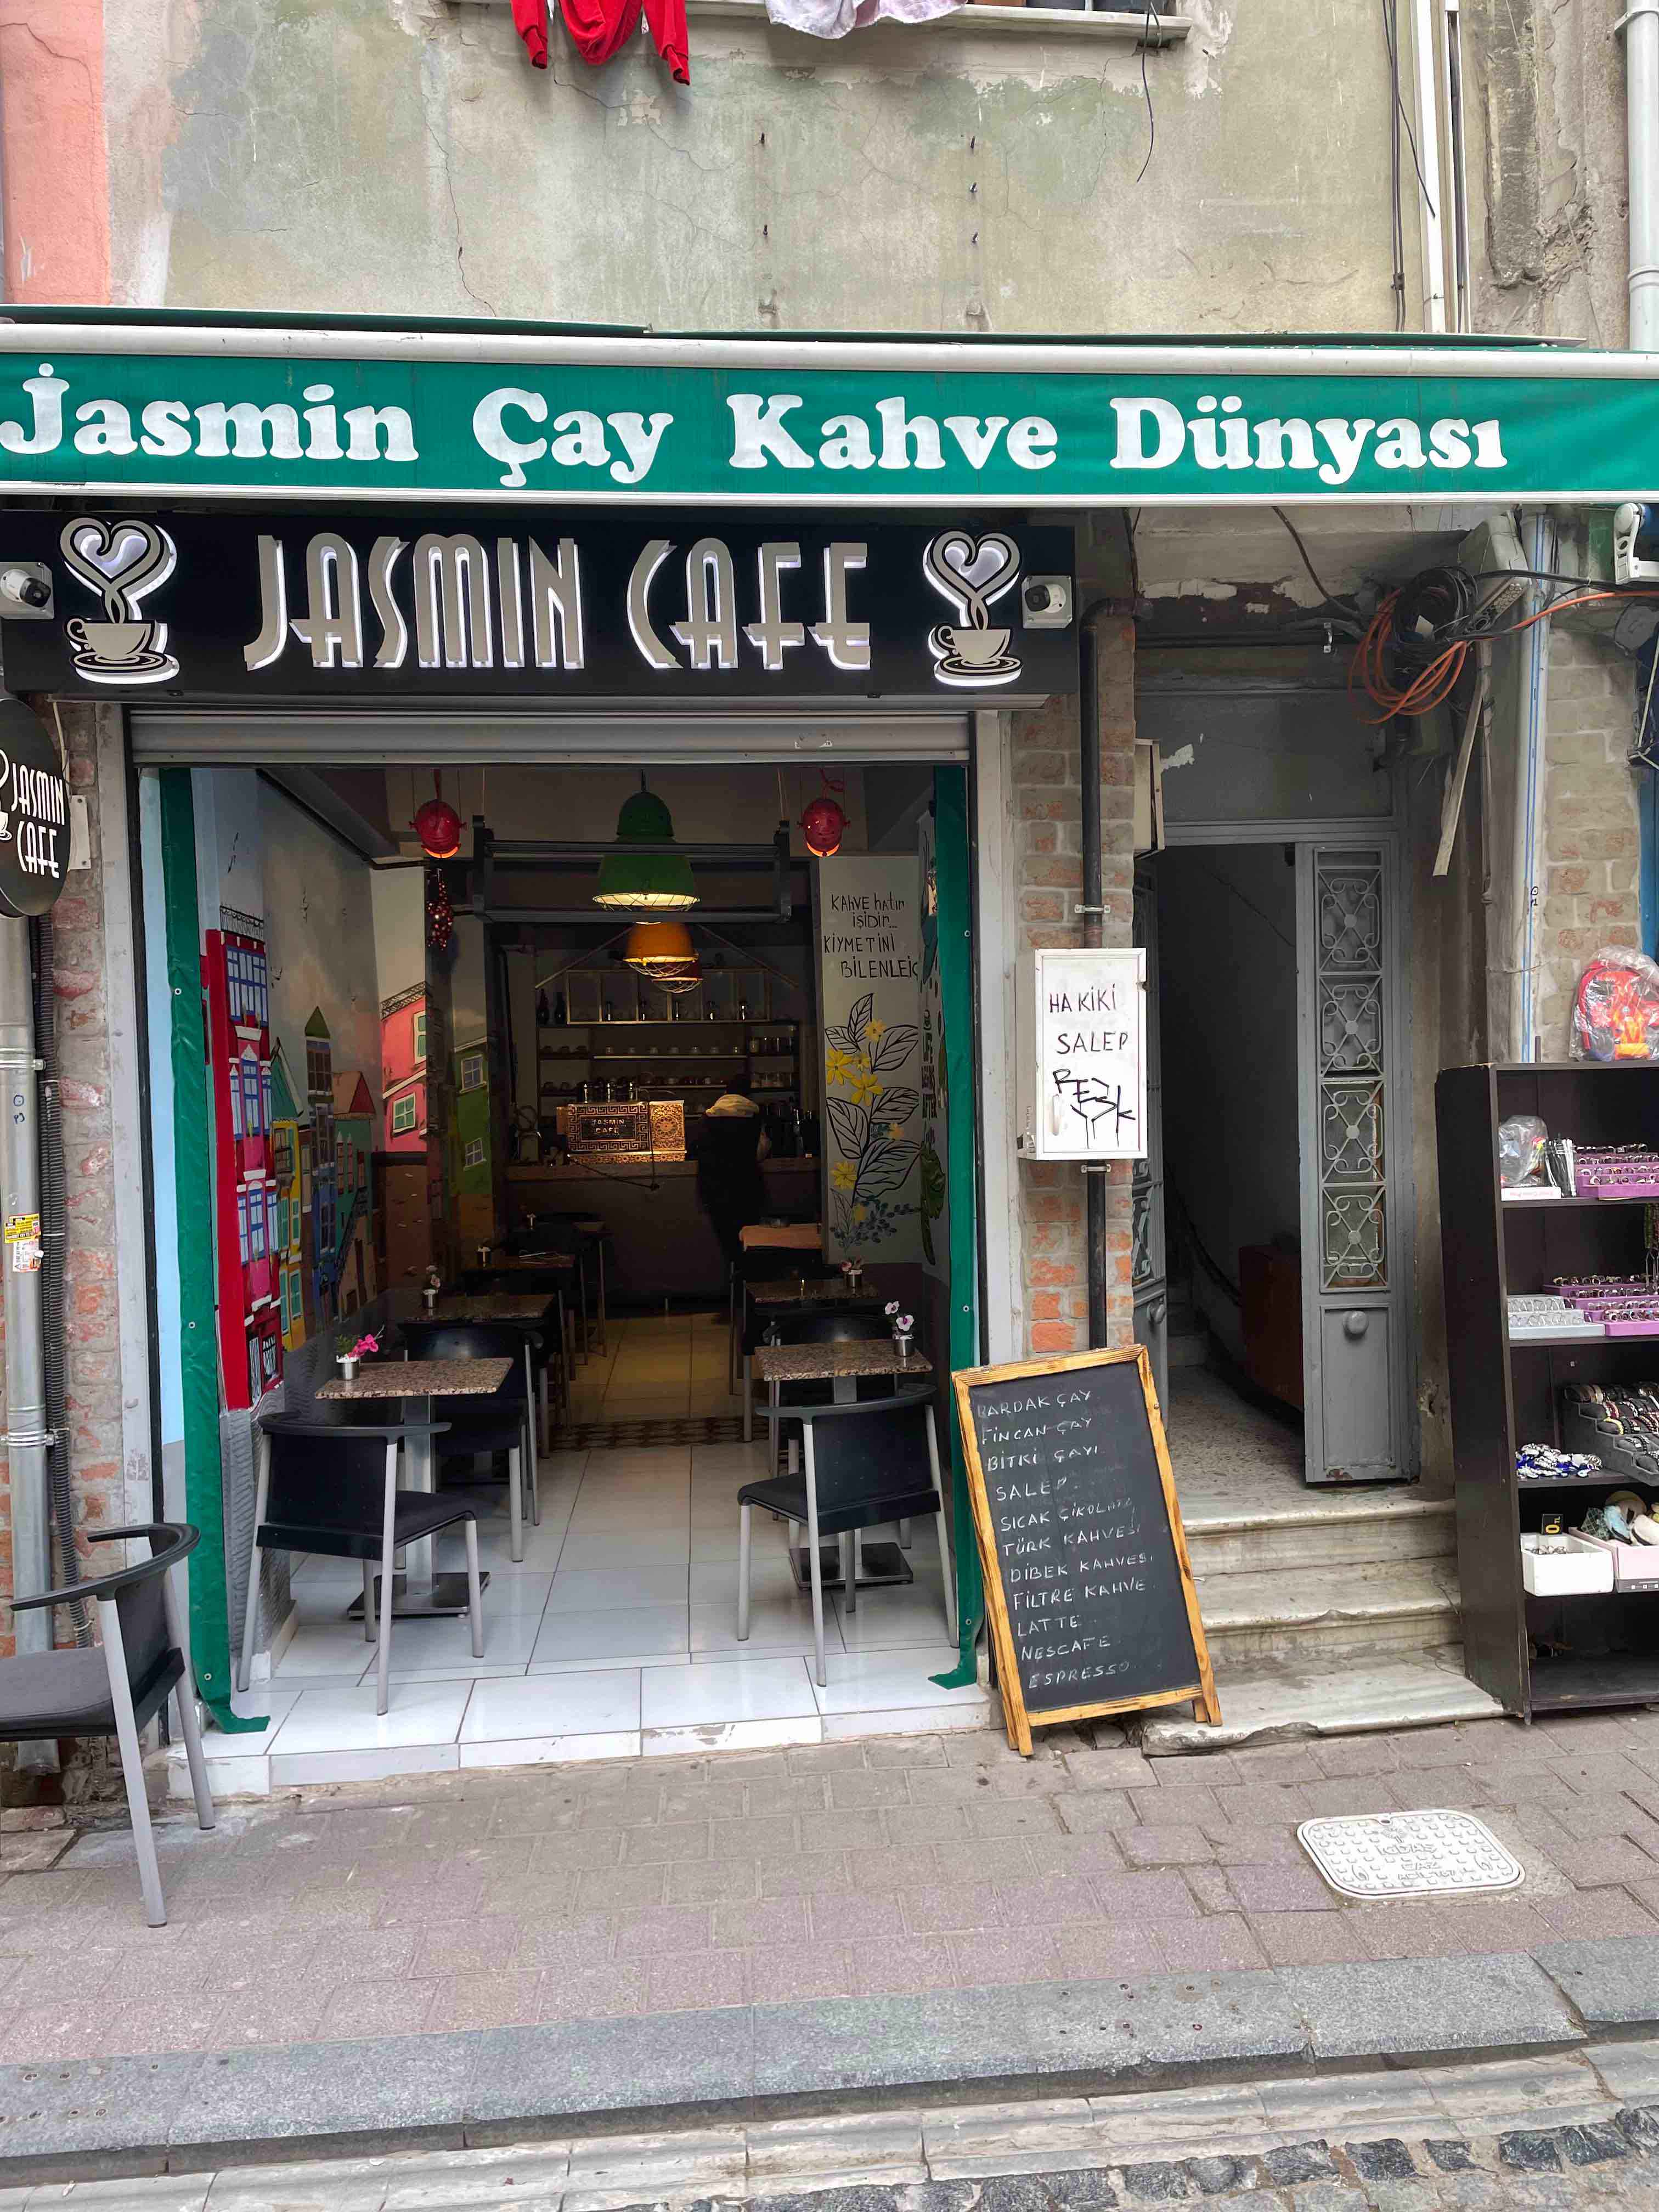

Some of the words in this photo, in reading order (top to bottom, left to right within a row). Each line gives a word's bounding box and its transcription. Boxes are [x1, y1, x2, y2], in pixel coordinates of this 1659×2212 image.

[2, 362, 420, 462] Jasmin
[472, 387, 674, 487] Çay
[726, 393, 1059, 470] Kahve
[1109, 395, 1508, 487] Dünyası
[243, 531, 585, 671] JASMIN
[627, 539, 873, 672] CAFE
[11, 763, 65, 825] JASMIN
[17, 820, 59, 878] CAFE
[1056, 1031, 1128, 1054] SALEP
[977, 1395, 1051, 1418] BARDAK
[1057, 1389, 1091, 1407] ÇAY
[981, 1424, 1047, 1444] FİNCAN
[1056, 1417, 1092, 1435] ÇAY
[987, 1448, 1037, 1471] BİTKİ
[1054, 1445, 1098, 1463] ÇAYI
[996, 1476, 1067, 1502] SALEP
[1000, 1511, 1051, 1532] SICAK
[1002, 1537, 1052, 1557] TÜRK
[1010, 1563, 1068, 1583] DİBEK
[1013, 1589, 1074, 1611] FİLTRE
[1085, 1576, 1147, 1598] KAHVE
[1017, 1615, 1080, 1637] LATTE
[1020, 1635, 1111, 1661] NESCAFE
[1028, 1661, 1130, 1689] ESPRESSO
